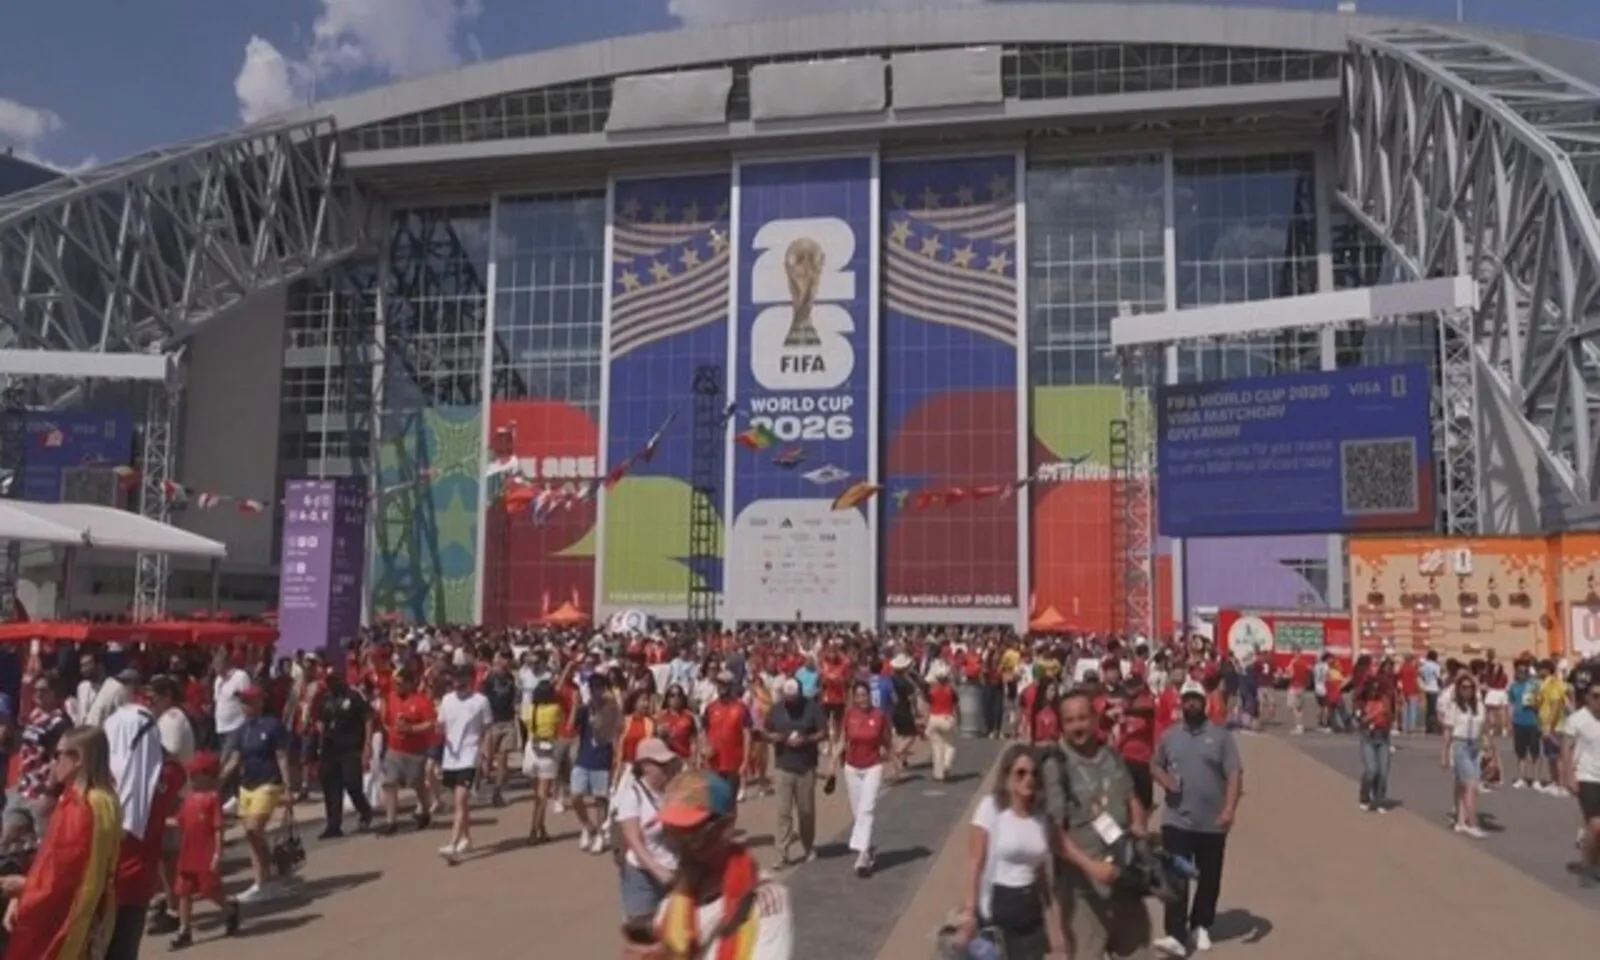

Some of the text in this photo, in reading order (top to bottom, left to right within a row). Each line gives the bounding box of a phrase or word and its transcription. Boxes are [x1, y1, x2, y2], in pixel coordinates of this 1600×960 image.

[780, 355, 826, 373] FIFA
[1200, 389, 1253, 407] WORLD
[1254, 387, 1286, 402] CUP
[1346, 381, 1382, 396] VISA
[751, 396, 853, 413] WORLD CUP
[750, 415, 853, 441] 2026
